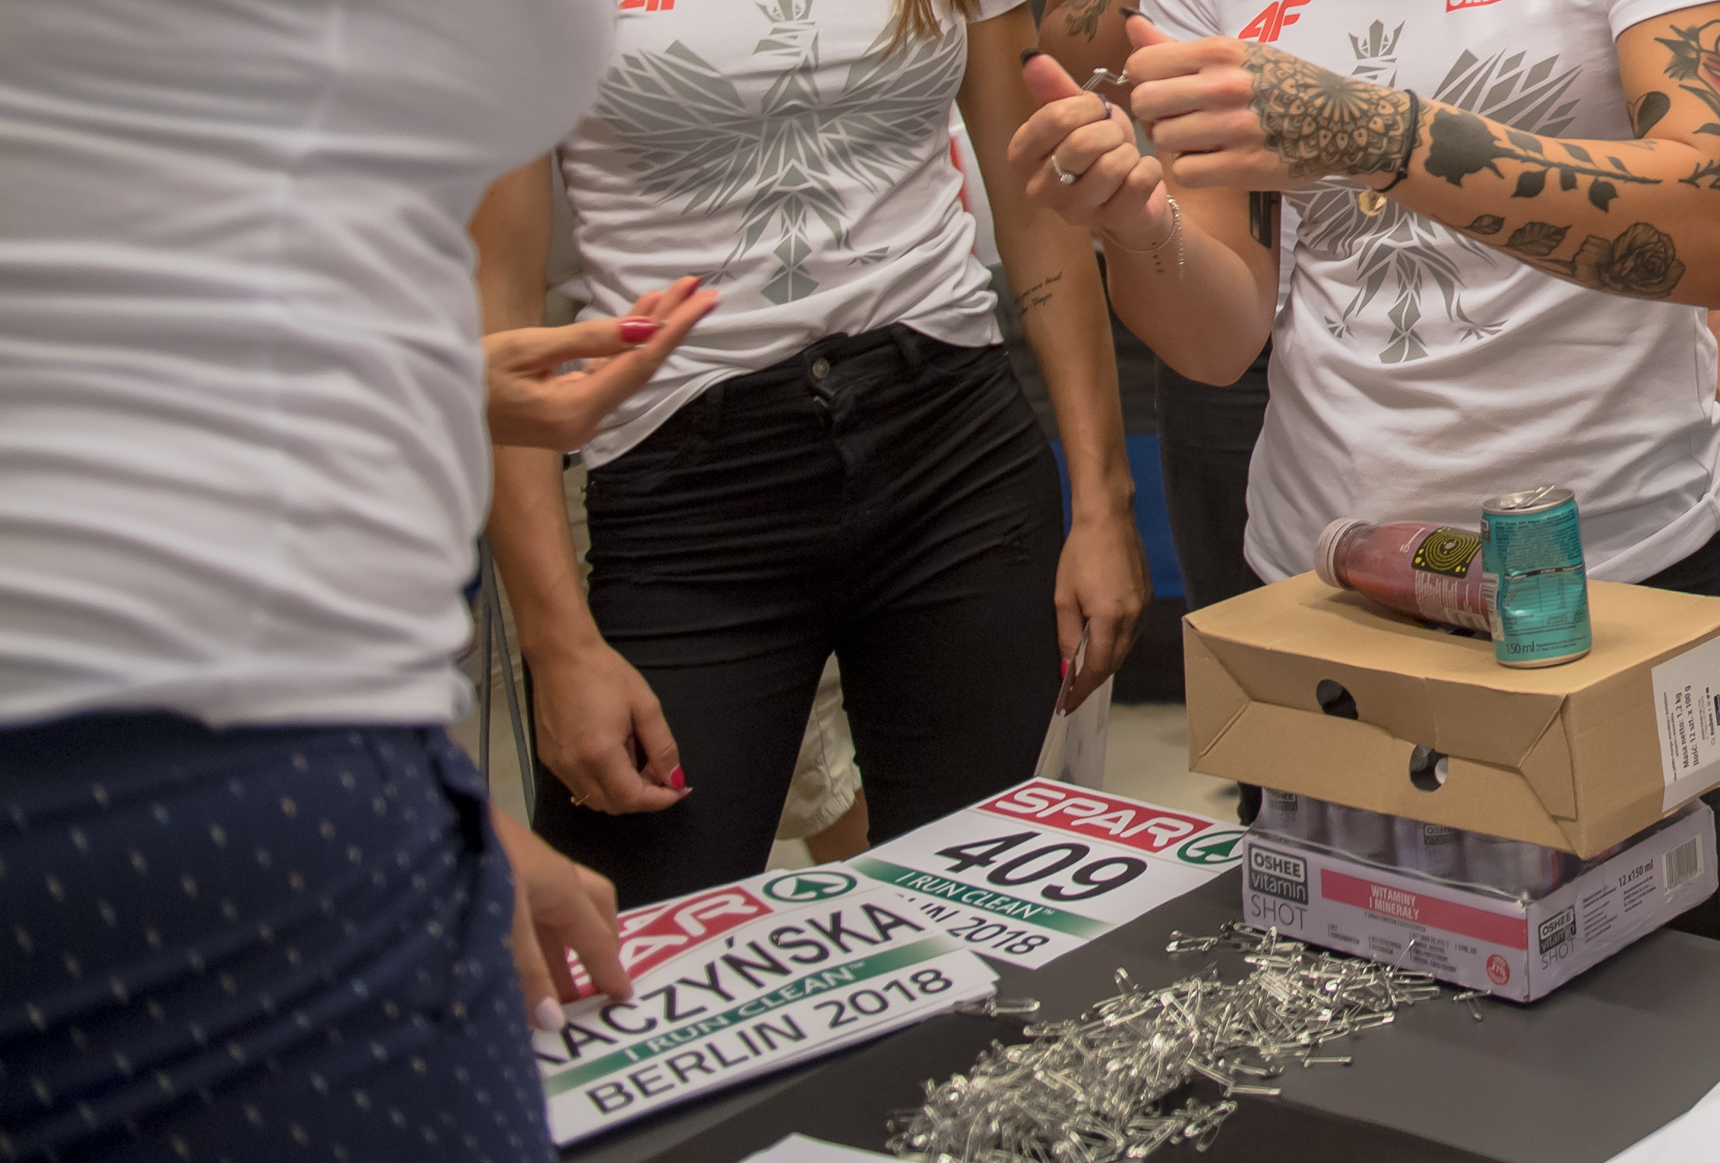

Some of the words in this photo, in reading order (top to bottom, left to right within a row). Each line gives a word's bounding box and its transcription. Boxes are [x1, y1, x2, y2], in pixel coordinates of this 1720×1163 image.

[1522, 641, 1535, 653] ml
[995, 787, 1195, 848] SPAR
[934, 831, 1149, 903] 409
[1253, 850, 1302, 878] OSHEE
[1645, 859, 1654, 873] ml
[896, 873, 910, 883] I
[916, 875, 964, 899] RUN
[1251, 871, 1307, 902] vitamin
[1370, 884, 1417, 908] WITAMINY
[1250, 894, 1308, 930] SHOT
[1542, 911, 1572, 936] OSHEE
[946, 916, 1051, 956] 2018
[1541, 941, 1575, 971] SHOT
[585, 1014, 807, 1115] BERLIN
[814, 968, 953, 1030] 2018
[624, 1048, 640, 1063] I
[647, 1015, 730, 1055] RUN
